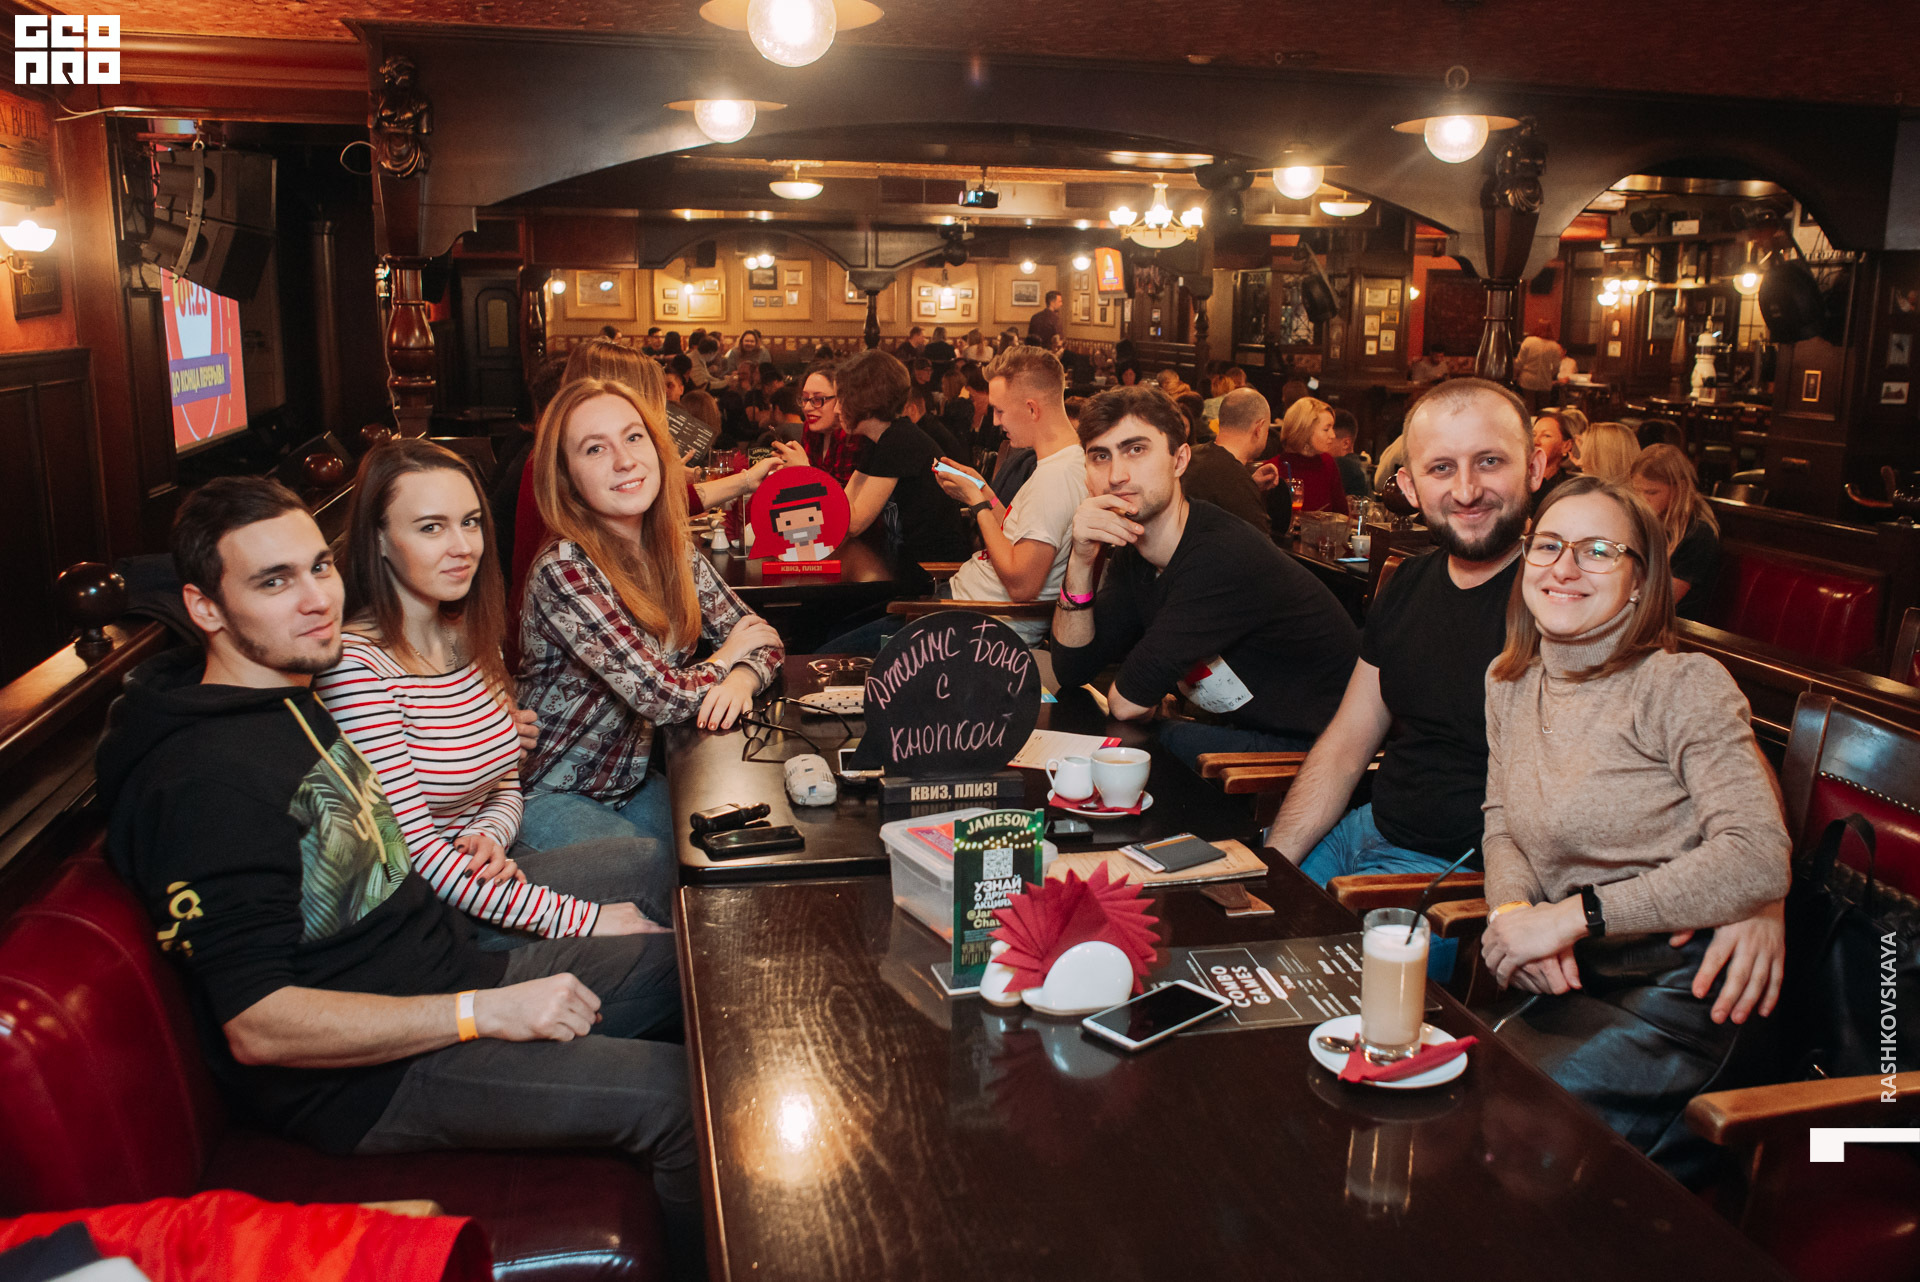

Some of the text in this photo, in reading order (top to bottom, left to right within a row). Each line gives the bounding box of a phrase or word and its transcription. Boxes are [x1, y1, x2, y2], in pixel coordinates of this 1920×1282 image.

[969, 619, 1032, 698] Бонд
[911, 782, 998, 801] КВИЗ, ПЛИЗ!
[966, 813, 1030, 835] JAMESON
[974, 873, 1022, 894] УЗНАЙ
[1210, 965, 1252, 1008] COMBO
[1230, 965, 1272, 1005] GAMES
